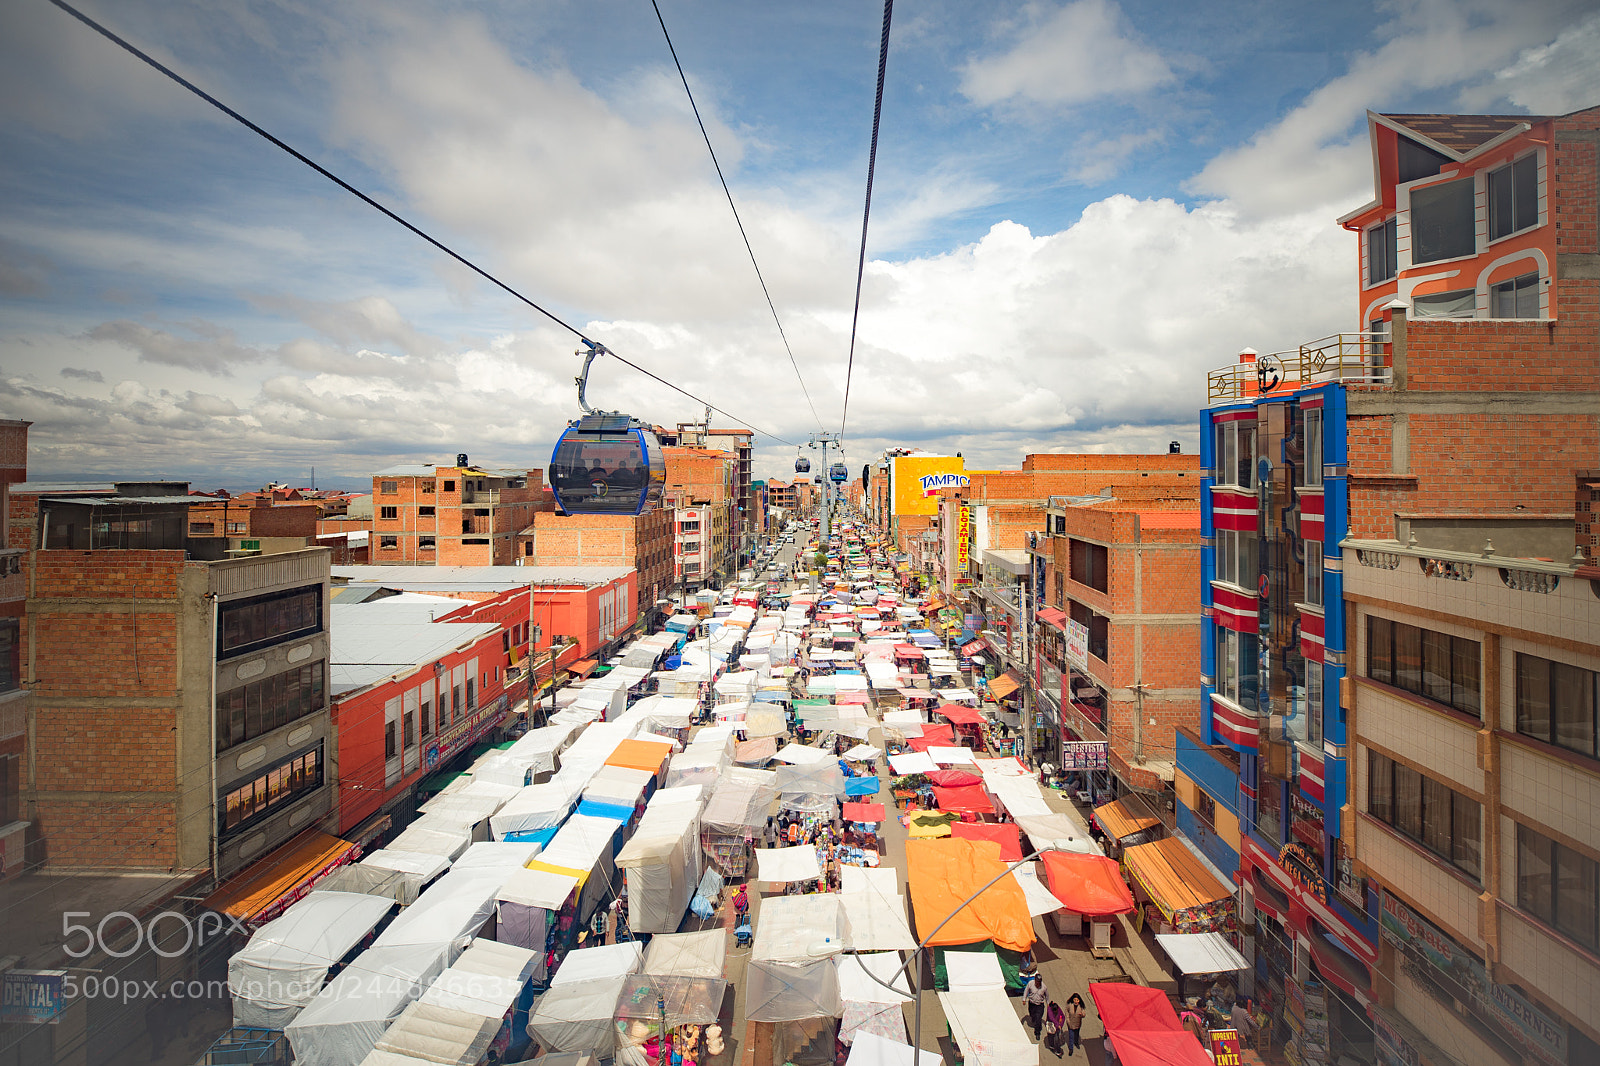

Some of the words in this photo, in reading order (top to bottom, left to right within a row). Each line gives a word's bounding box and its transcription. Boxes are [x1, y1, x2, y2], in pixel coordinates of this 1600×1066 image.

[919, 474, 971, 489] TAMPIC
[958, 507, 969, 563] ALOJAMIENTO
[1070, 743, 1105, 753] DENTISTA
[1277, 843, 1305, 868] SHOPPING
[1306, 856, 1326, 905] CENTER
[1284, 859, 1302, 883] MEGA
[5, 975, 33, 983] CLINICA
[3, 982, 53, 1007] DENTAL
[1489, 983, 1562, 1049] INTERNET
[1210, 1032, 1237, 1041] IMPRENTA
[1215, 1053, 1240, 1066] INTI
